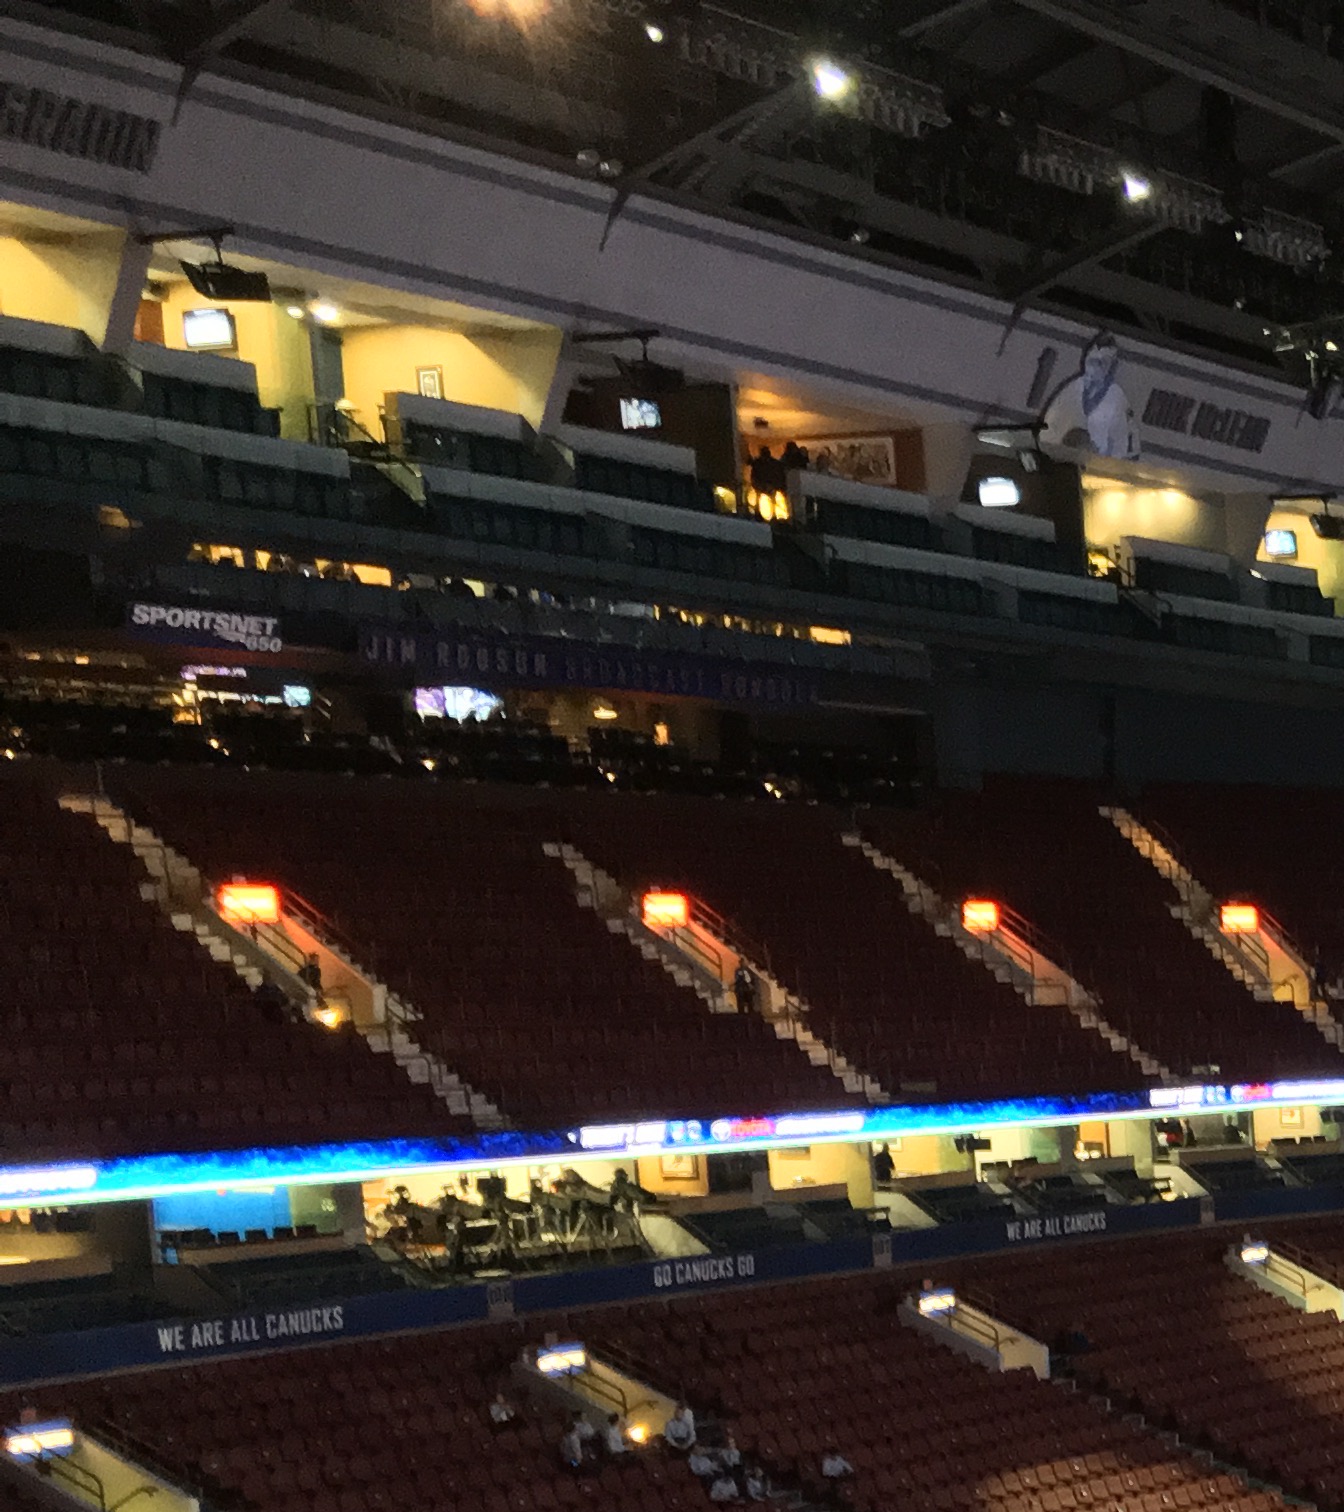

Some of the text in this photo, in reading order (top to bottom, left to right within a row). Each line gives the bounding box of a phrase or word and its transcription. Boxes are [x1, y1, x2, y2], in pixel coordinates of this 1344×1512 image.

[131, 602, 280, 636] SPORTSNET
[1006, 1209, 1108, 1243] WE ARE ALL CANUCKS
[652, 1254, 755, 1288] GO CANUCKS GO
[156, 1306, 345, 1354] WE ARE ALL CANUCKS
